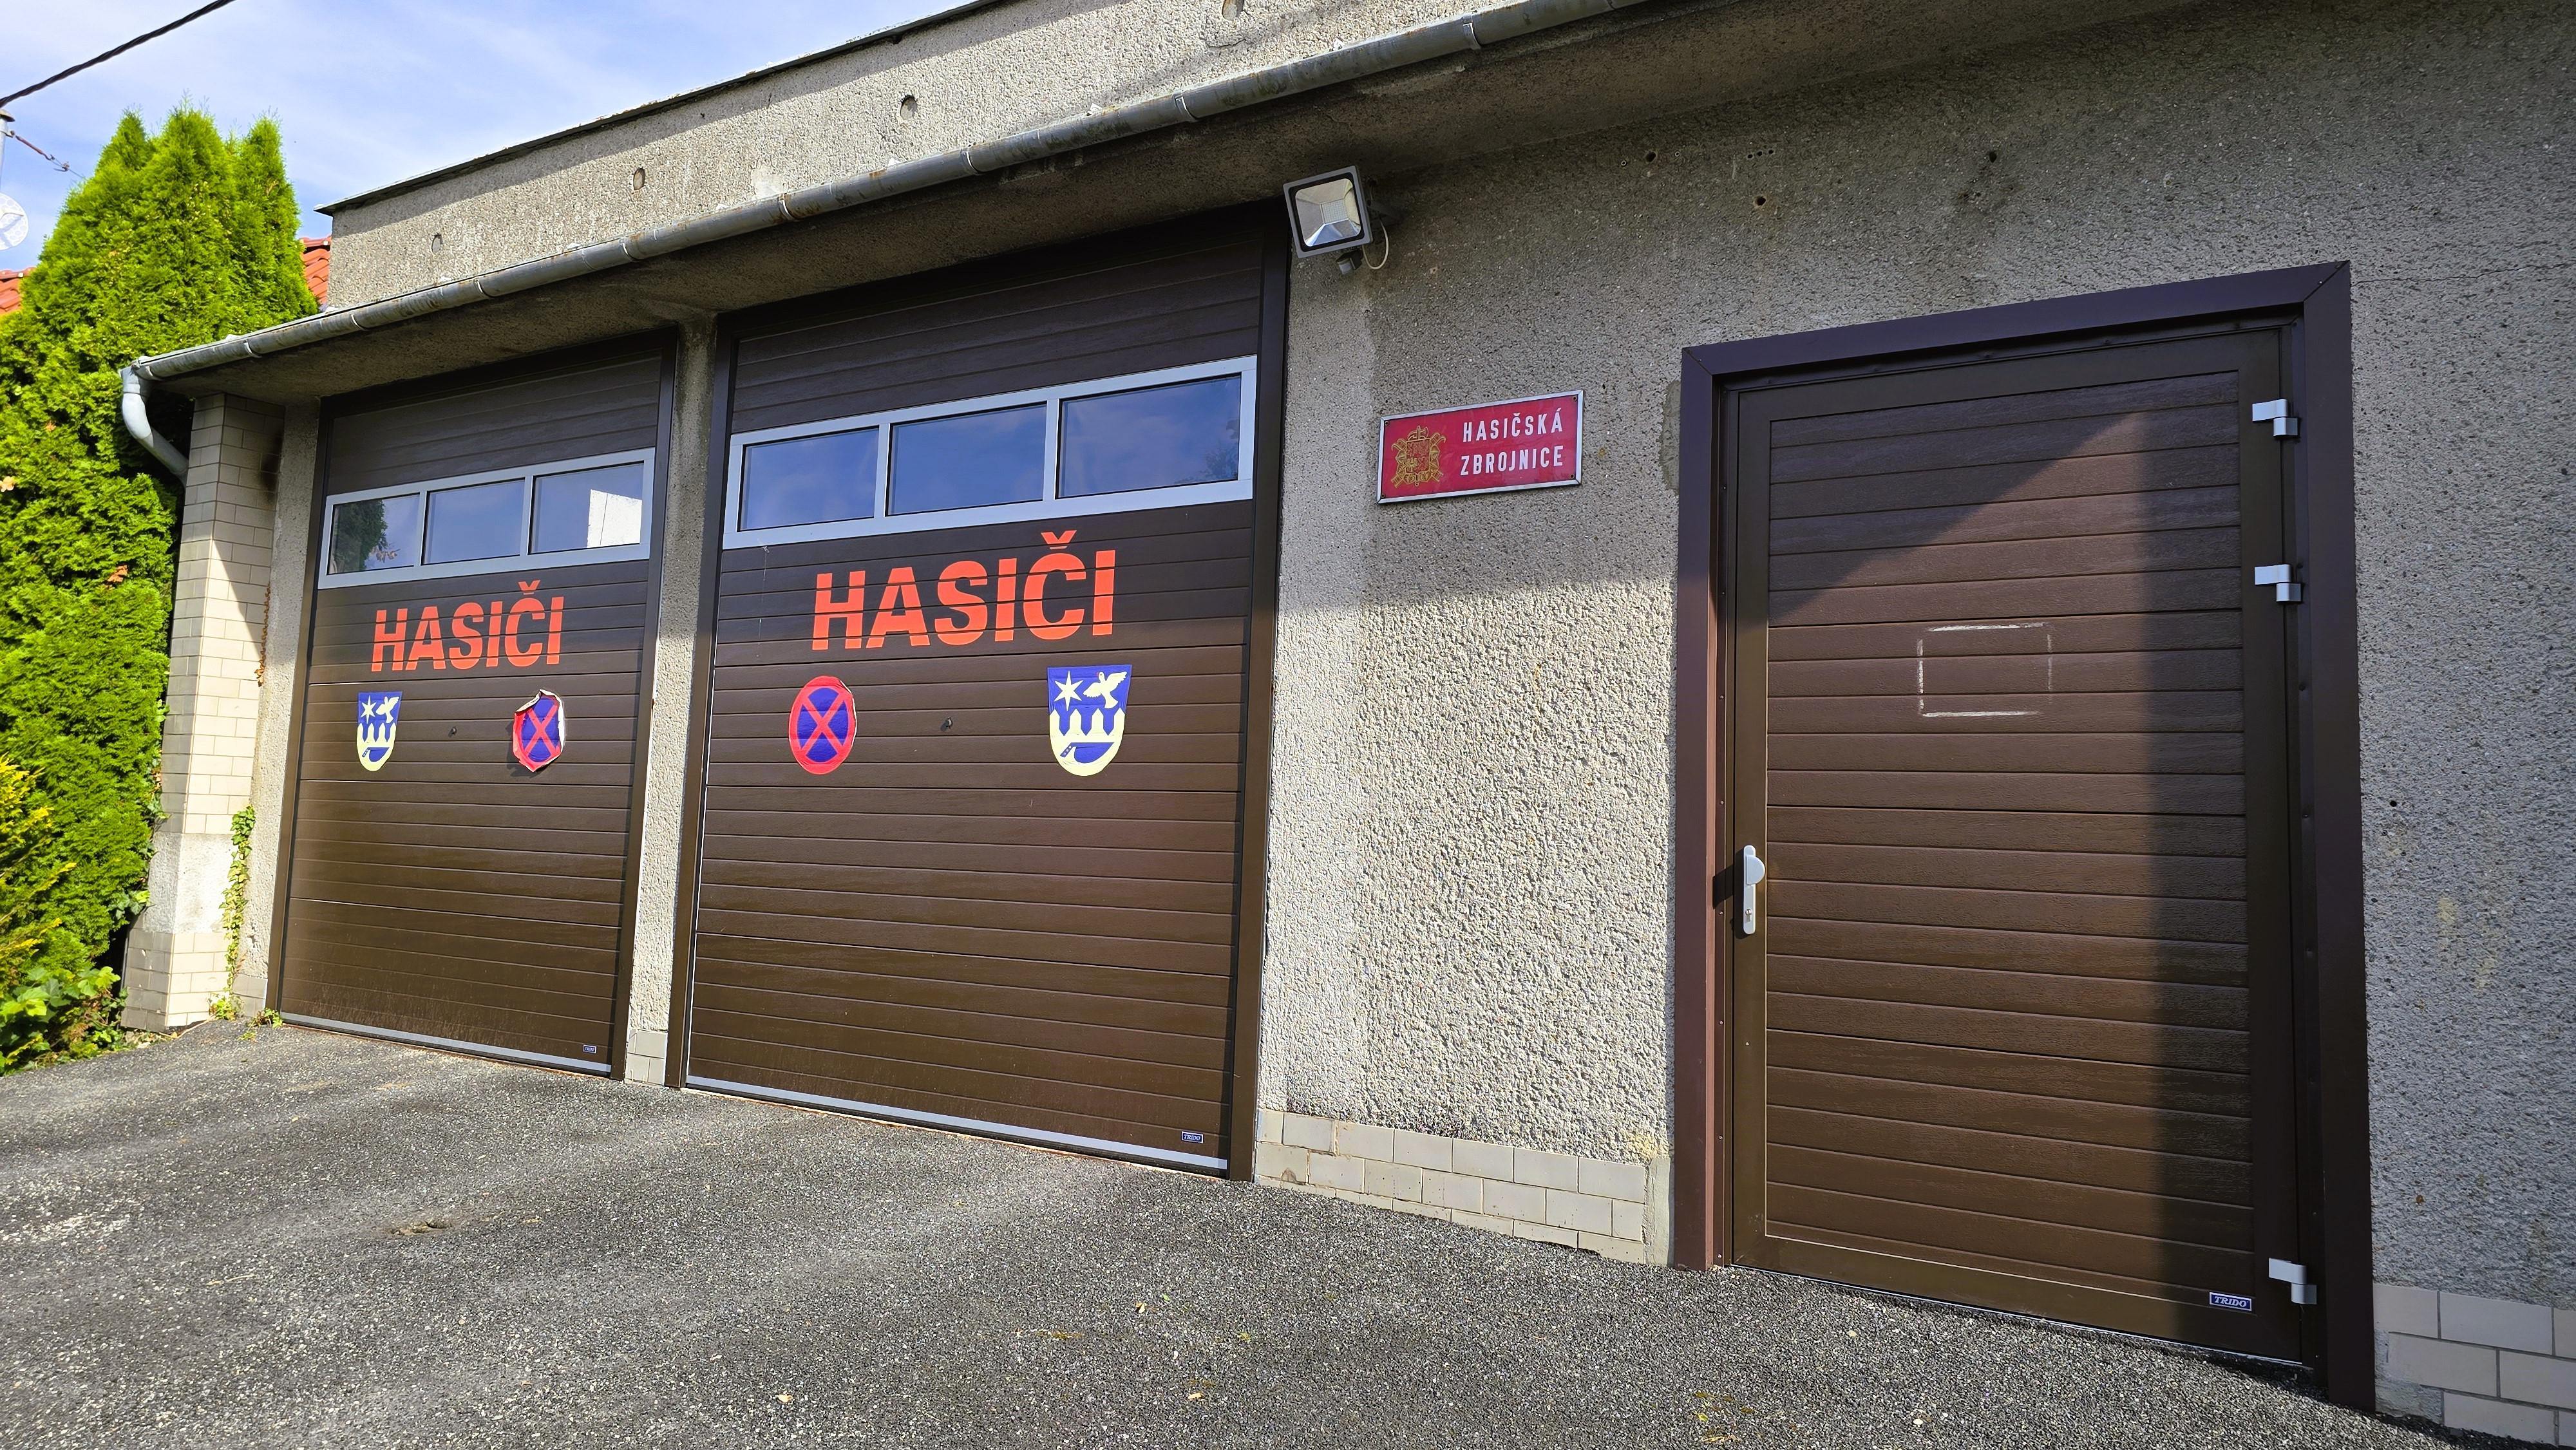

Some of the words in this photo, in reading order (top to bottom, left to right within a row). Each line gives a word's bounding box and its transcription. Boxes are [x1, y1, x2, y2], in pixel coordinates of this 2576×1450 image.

[1463, 408, 1562, 442] HASIČSKÁ
[1460, 445, 1564, 476] ZBROJNICE
[811, 530, 1116, 650] HASIČI
[371, 579, 564, 672] HASIČI
[2214, 1296, 2247, 1308] TRIDO
